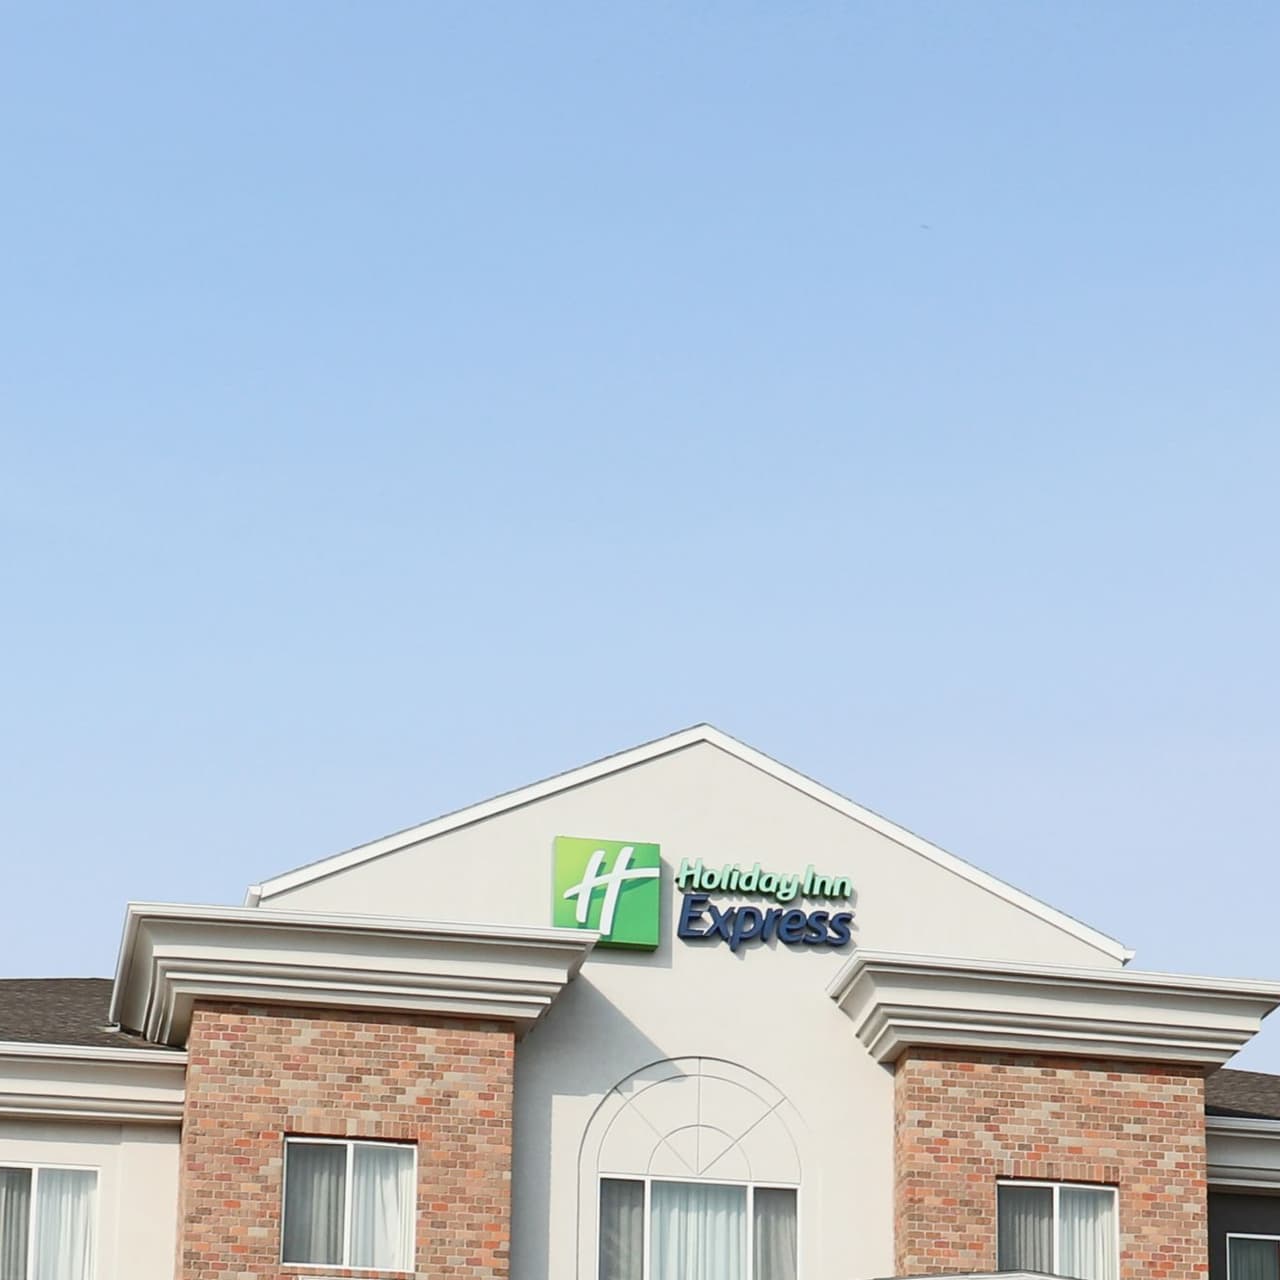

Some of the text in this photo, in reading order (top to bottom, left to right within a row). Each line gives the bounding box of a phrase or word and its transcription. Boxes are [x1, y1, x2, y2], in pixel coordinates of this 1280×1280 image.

[563, 846, 660, 936] H
[676, 857, 853, 902] Holiday Inn
[677, 893, 854, 951] Express
